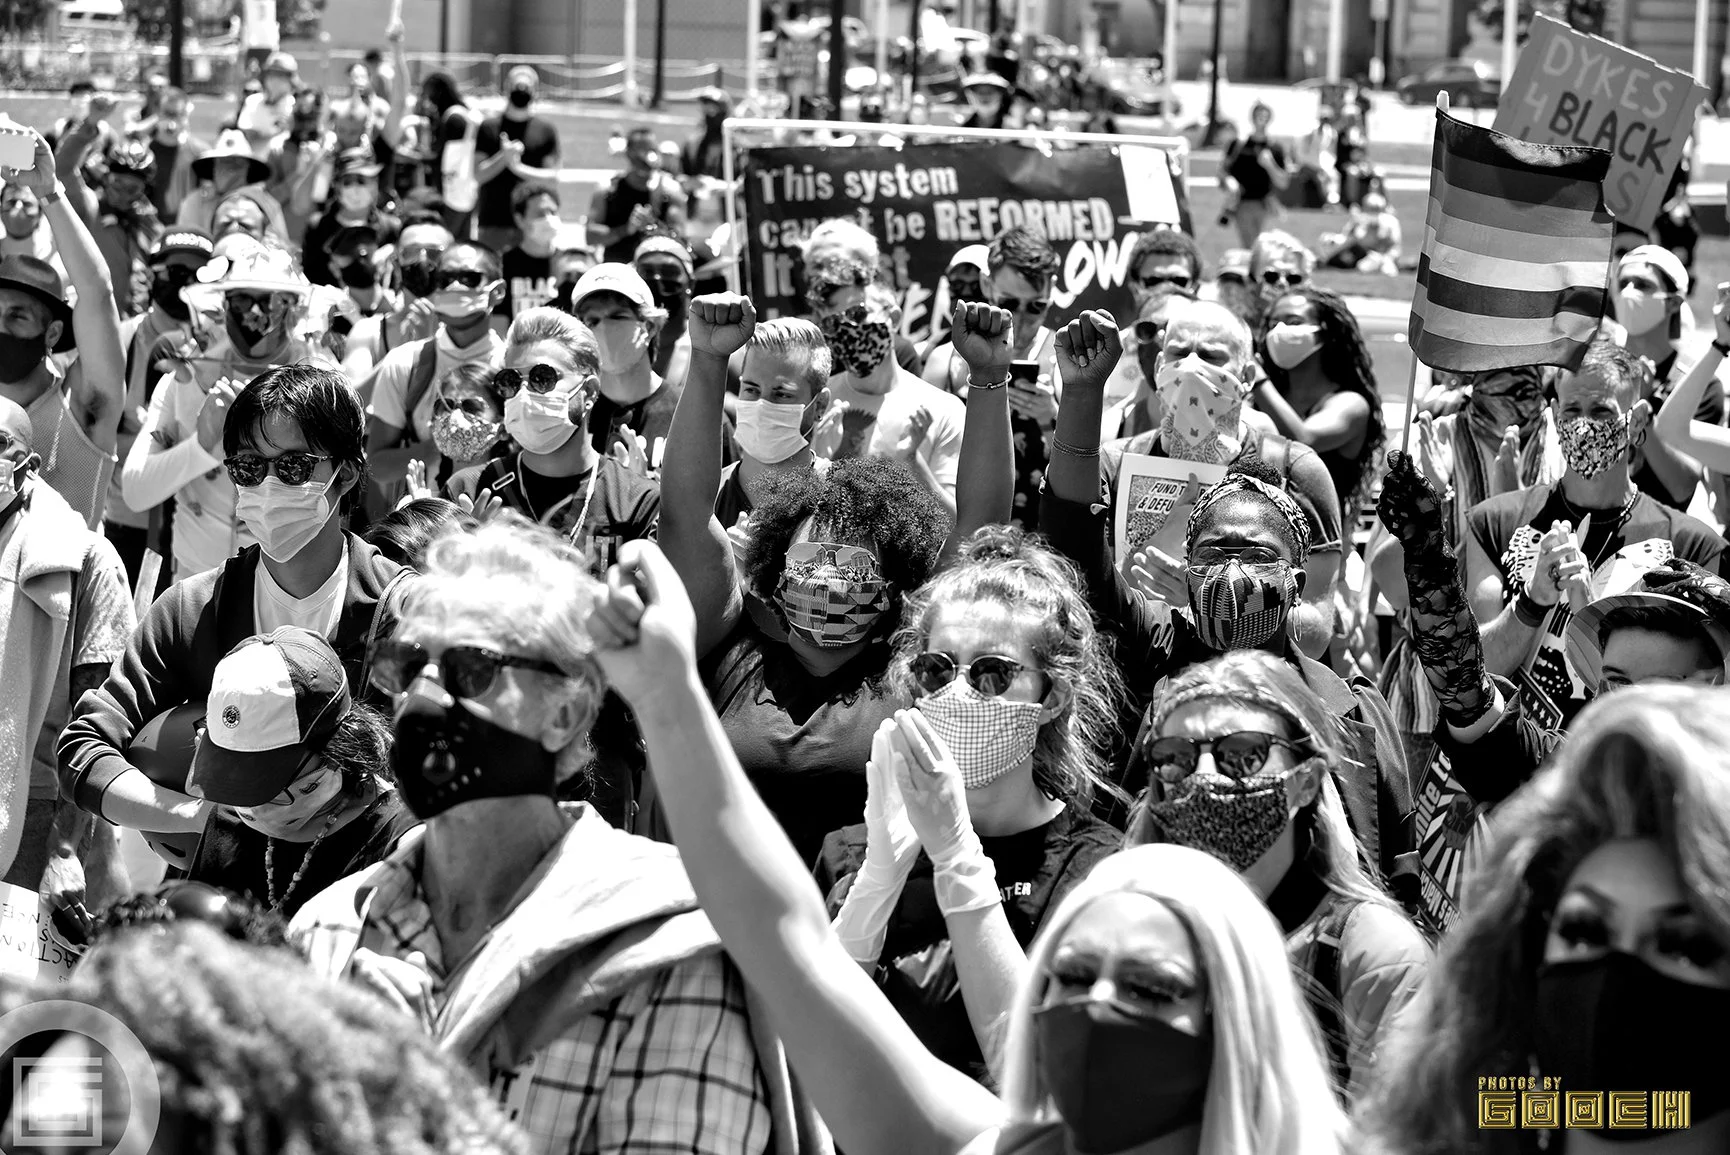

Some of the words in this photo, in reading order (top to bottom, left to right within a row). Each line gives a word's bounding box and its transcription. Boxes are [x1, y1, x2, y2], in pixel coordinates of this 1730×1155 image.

[1542, 34, 1674, 119] DYKES
[1524, 81, 1548, 123] 4
[1549, 91, 1672, 175] BLACK
[756, 164, 835, 204] This
[844, 163, 959, 203] system
[884, 207, 926, 244] be
[762, 252, 796, 297] It
[1138, 497, 1148, 509] &
[1147, 498, 1175, 512] DEFU
[1151, 482, 1178, 495] FUND
